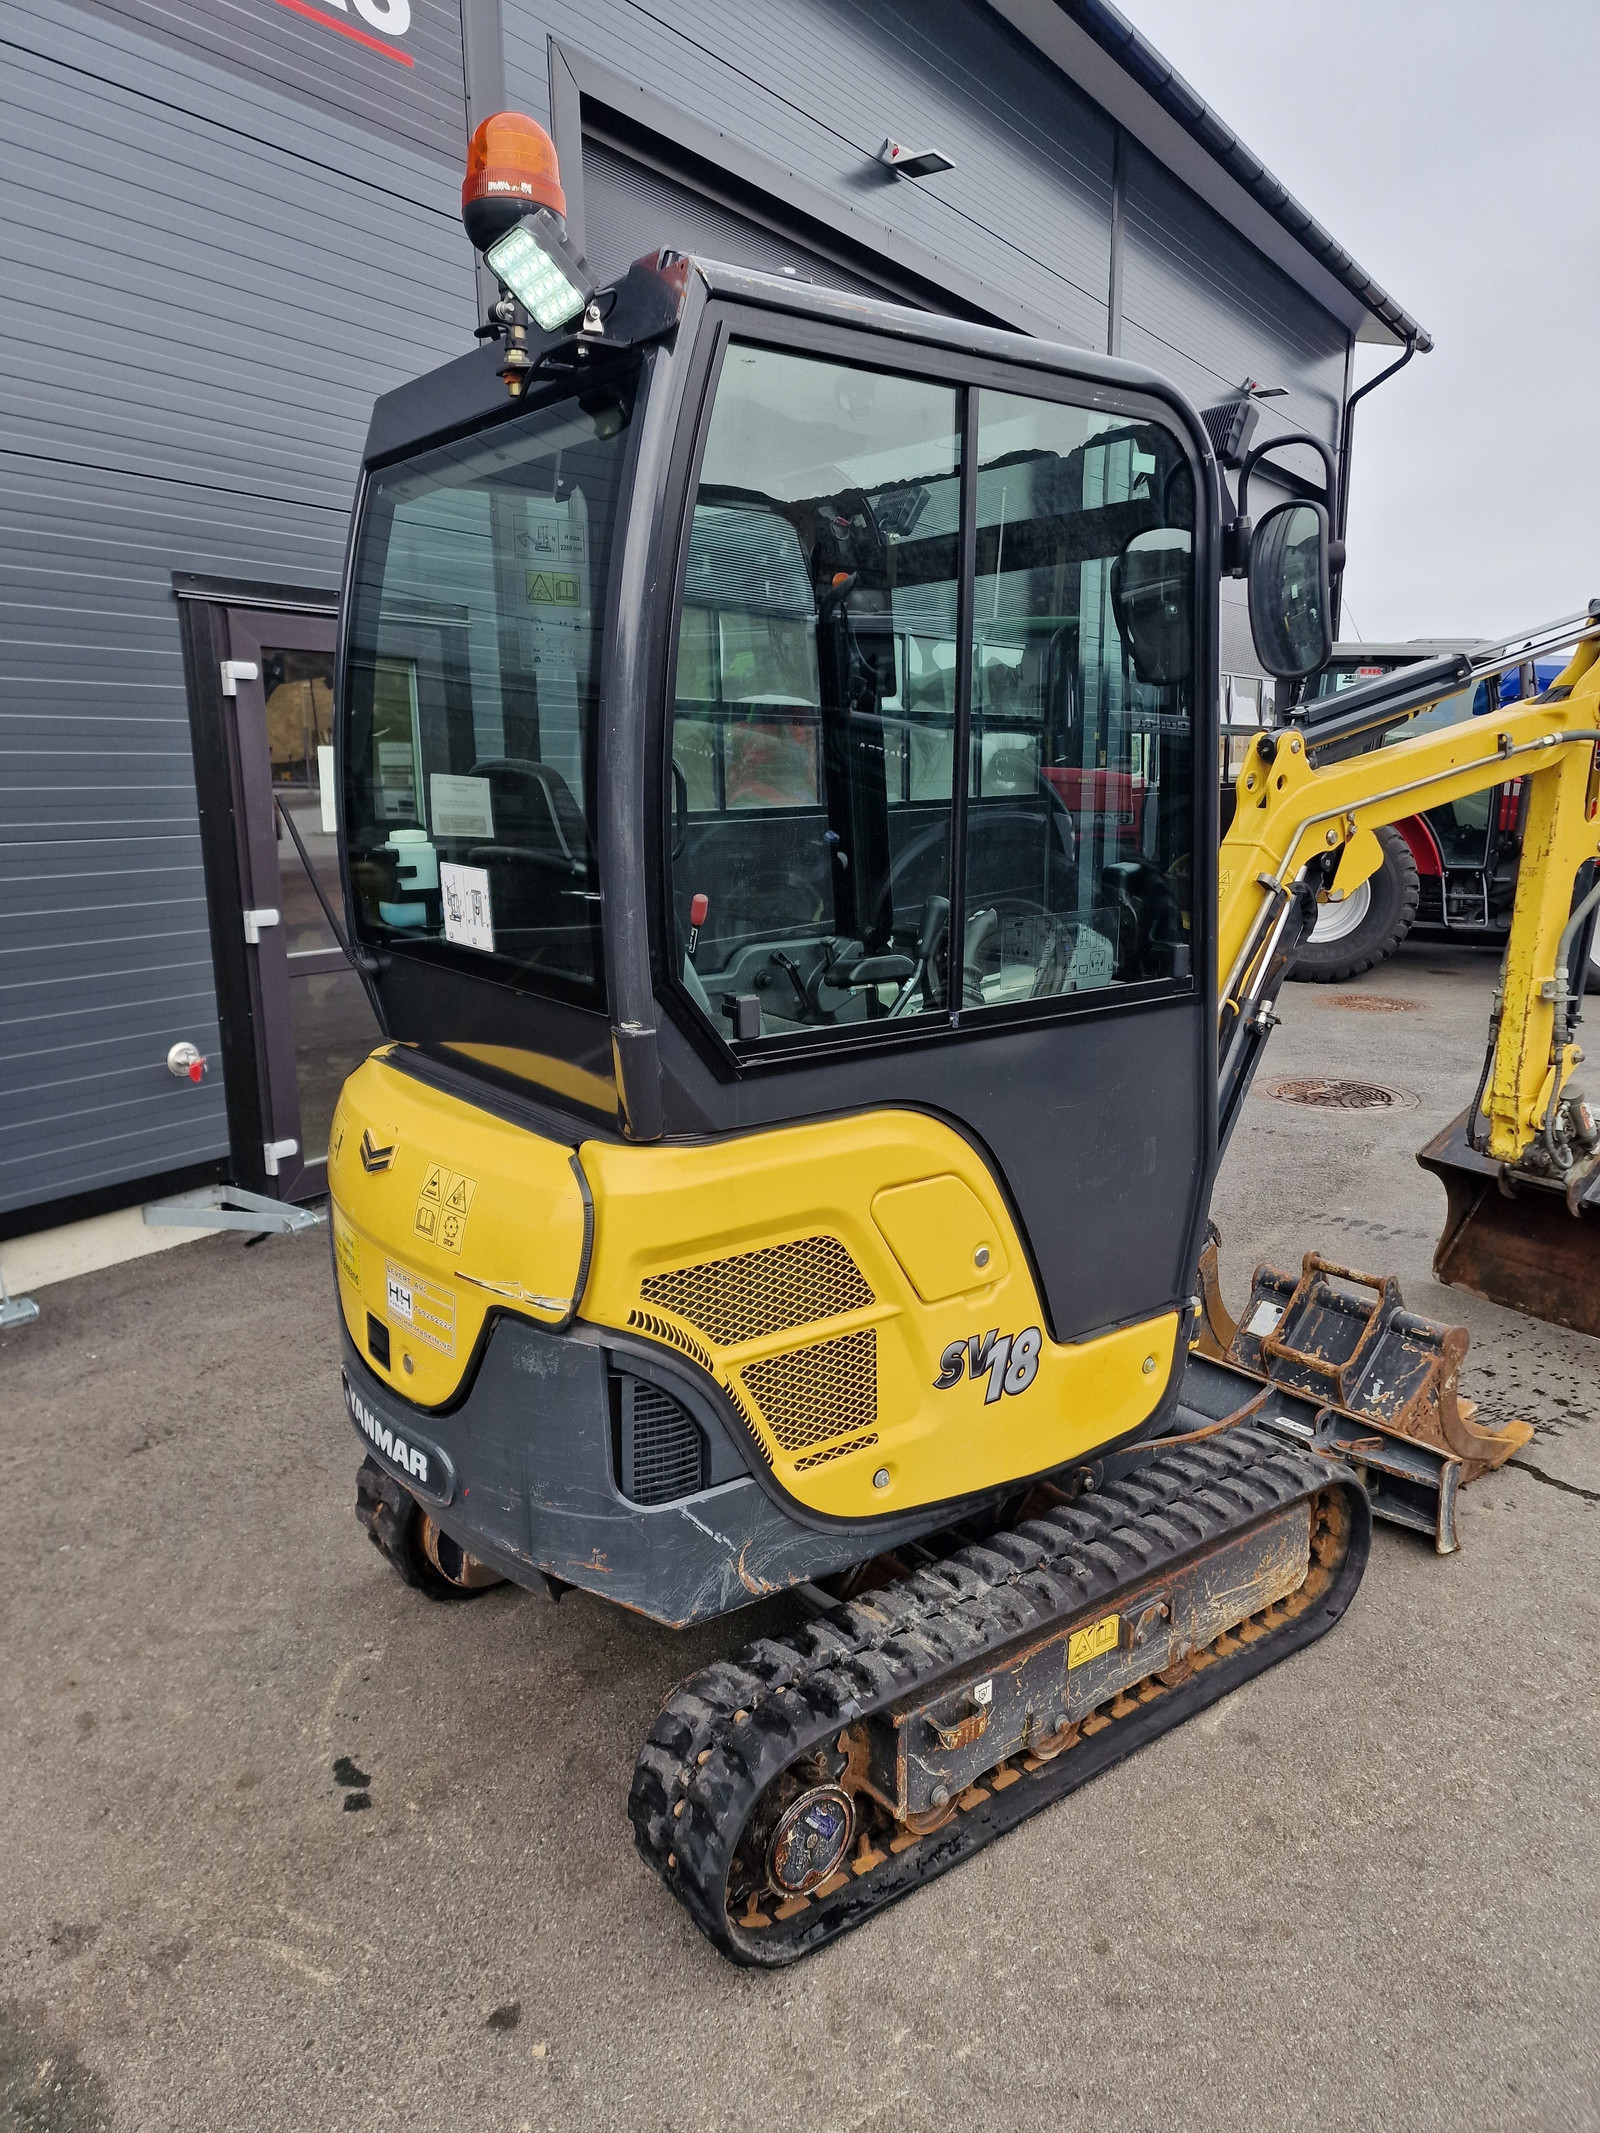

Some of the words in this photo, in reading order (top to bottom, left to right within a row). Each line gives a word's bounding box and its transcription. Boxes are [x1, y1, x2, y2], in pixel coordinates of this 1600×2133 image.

[443, 1238, 455, 1247] STOP
[386, 1264, 411, 1284] LEVERT
[932, 1326, 1042, 1406] SV18
[348, 1384, 428, 1482] YANMAR
